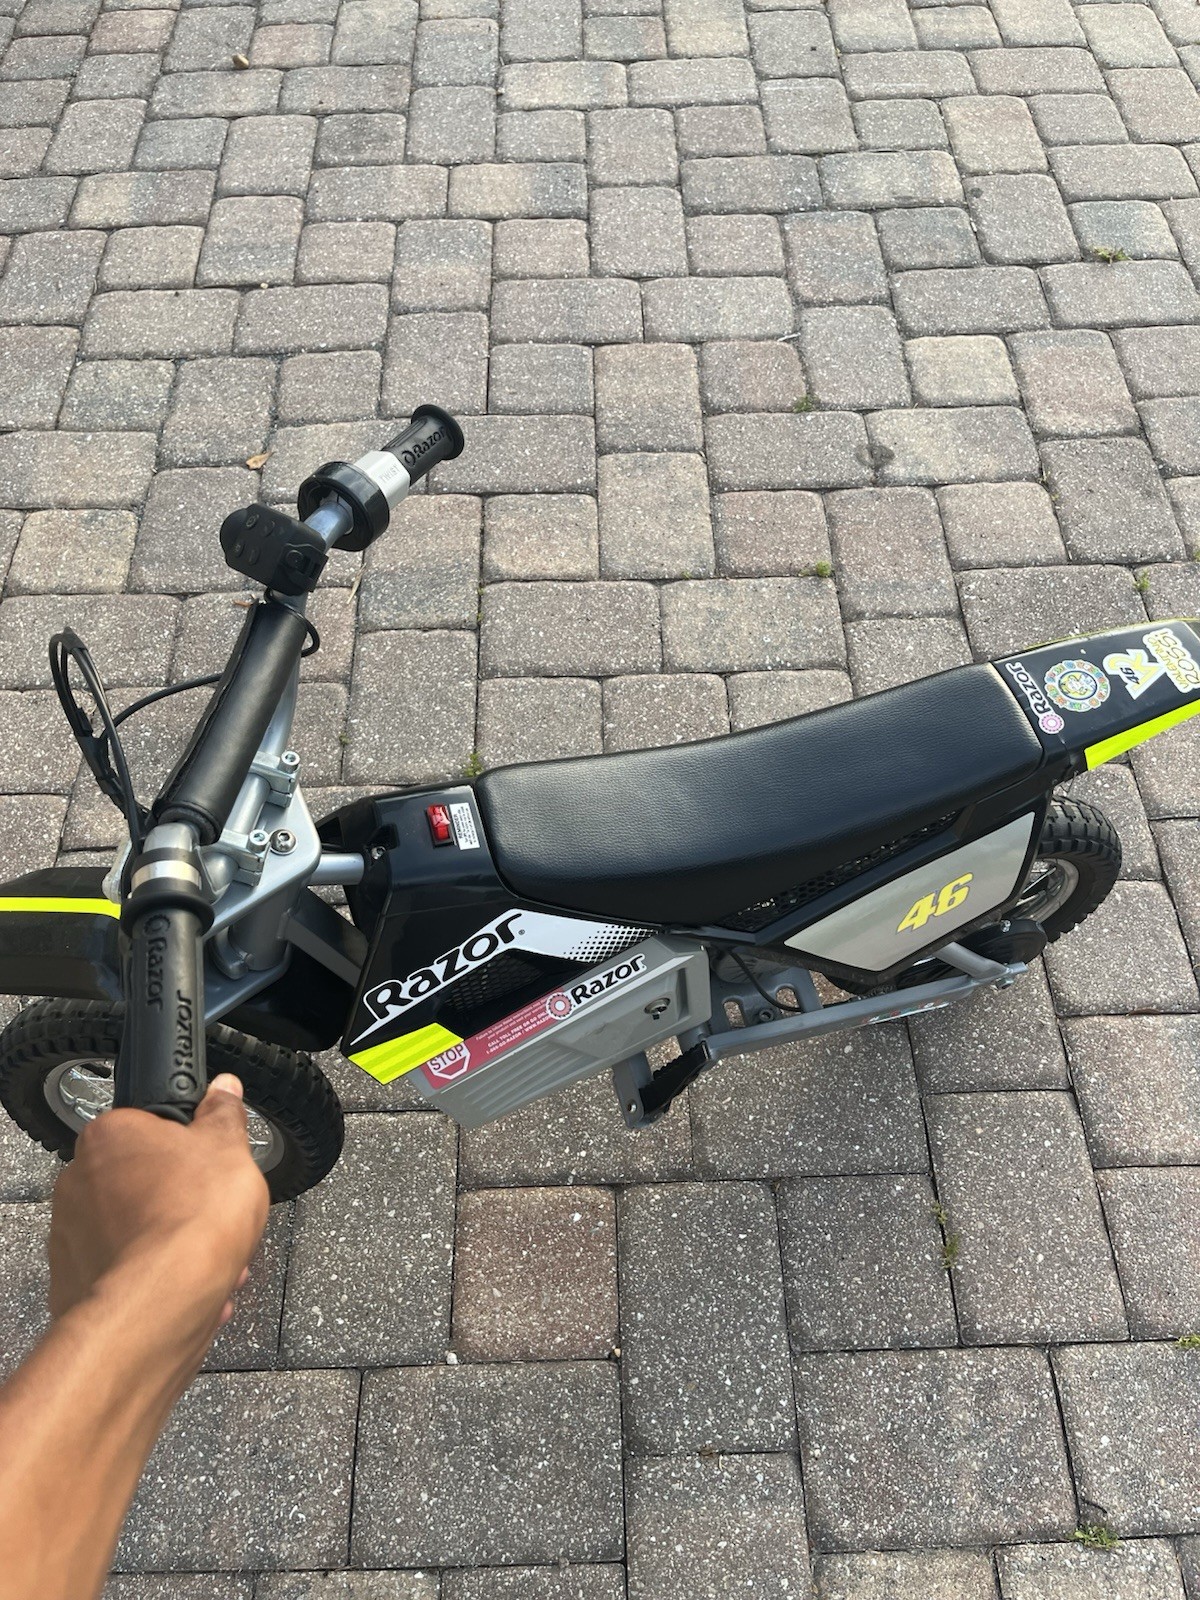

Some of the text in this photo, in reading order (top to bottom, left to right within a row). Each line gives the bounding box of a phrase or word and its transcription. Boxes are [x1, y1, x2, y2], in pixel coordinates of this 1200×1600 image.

[411, 426, 447, 458] Razor
[1007, 663, 1052, 715] Razor
[1120, 667, 1140, 684] 46
[896, 872, 974, 934] 46
[147, 936, 168, 1012] Razor
[364, 912, 523, 1020] Razor
[572, 954, 646, 1005] Razor
[173, 989, 193, 1070] Razor
[430, 1044, 464, 1072] STOP
